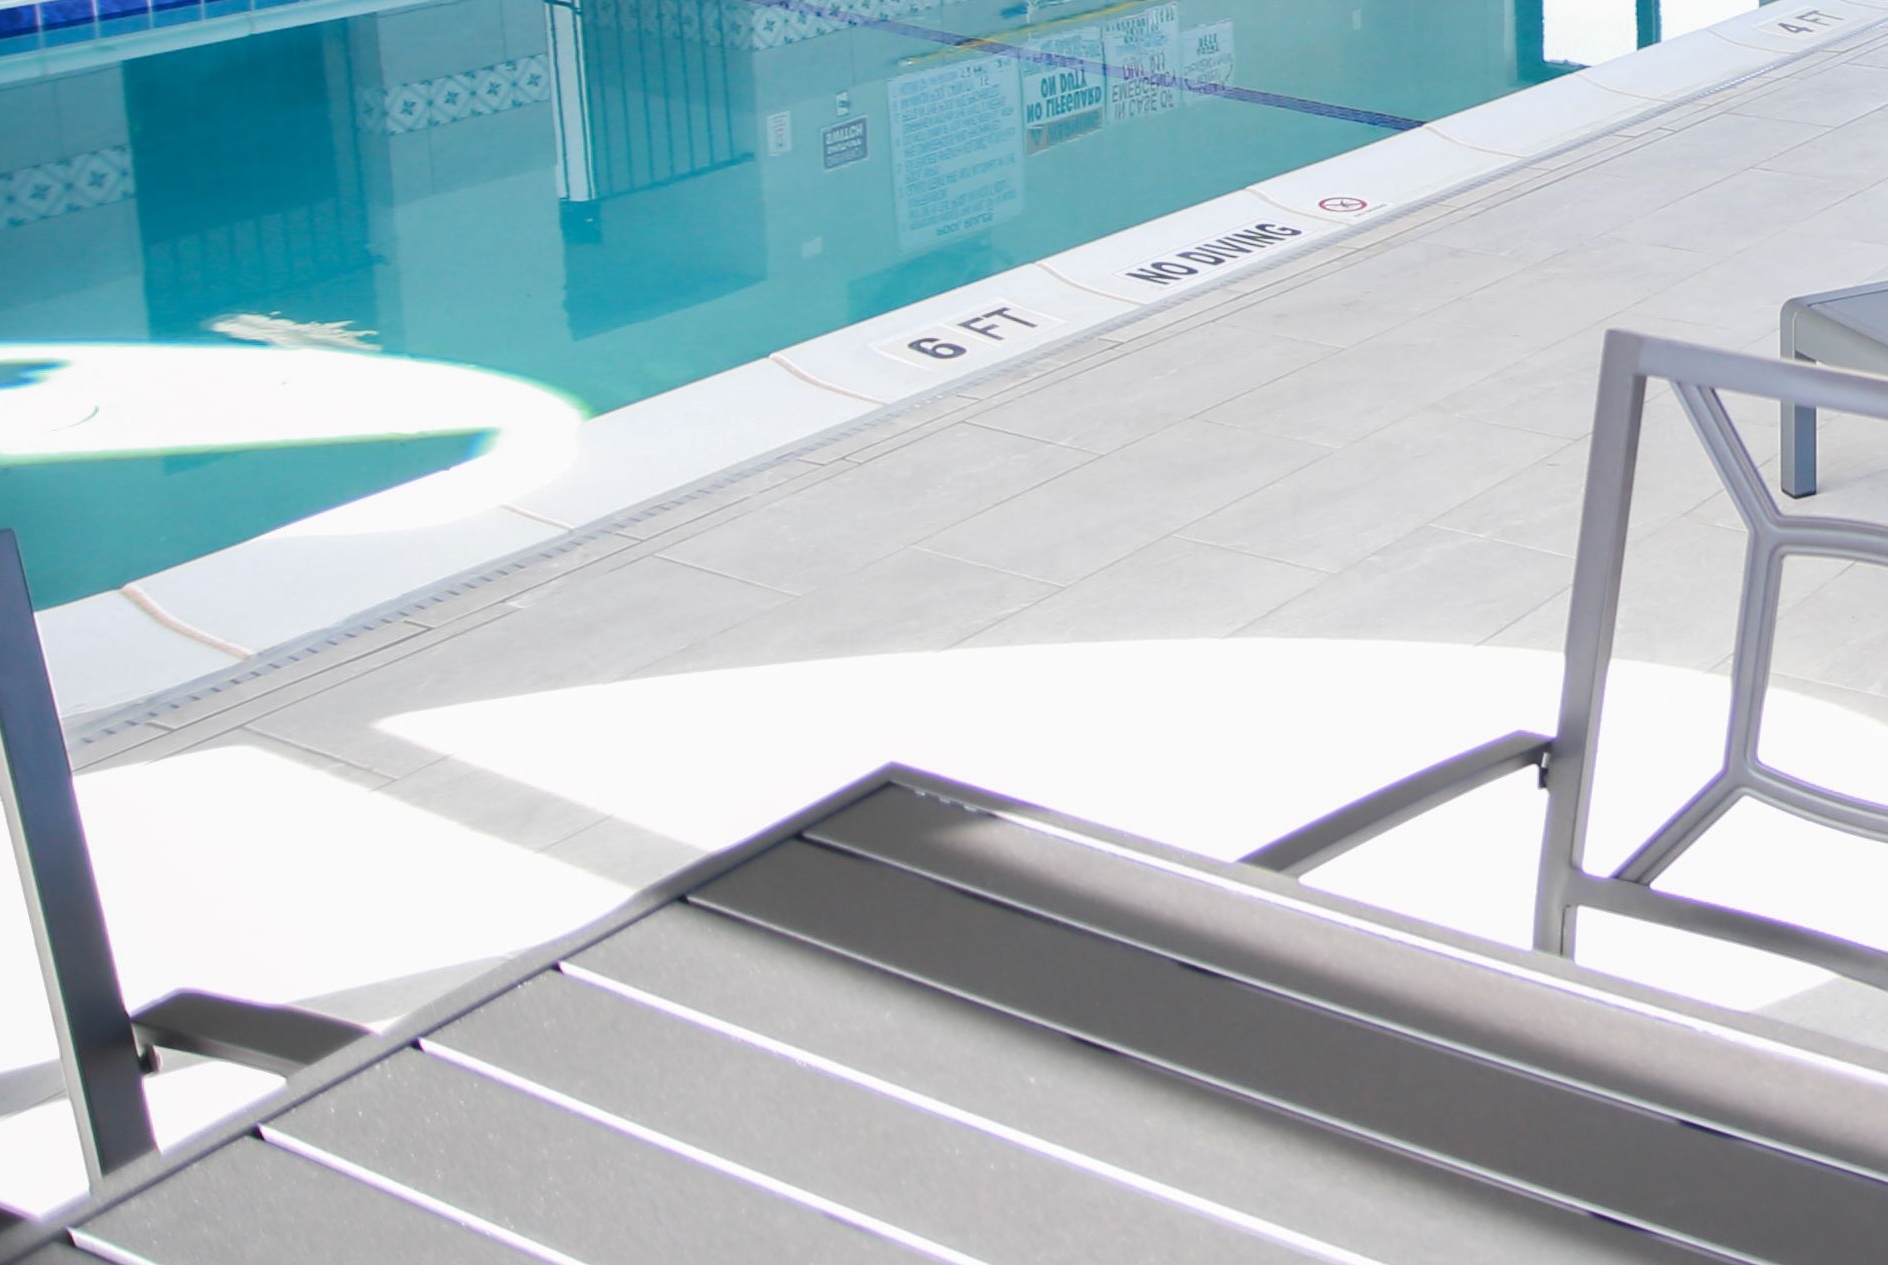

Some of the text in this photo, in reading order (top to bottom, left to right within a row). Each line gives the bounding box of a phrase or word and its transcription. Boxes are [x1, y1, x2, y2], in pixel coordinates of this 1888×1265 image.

[1777, 9, 1845, 35] 4 FT
[1124, 222, 1303, 286] NO DIVING
[906, 306, 1039, 360] 6 FT
